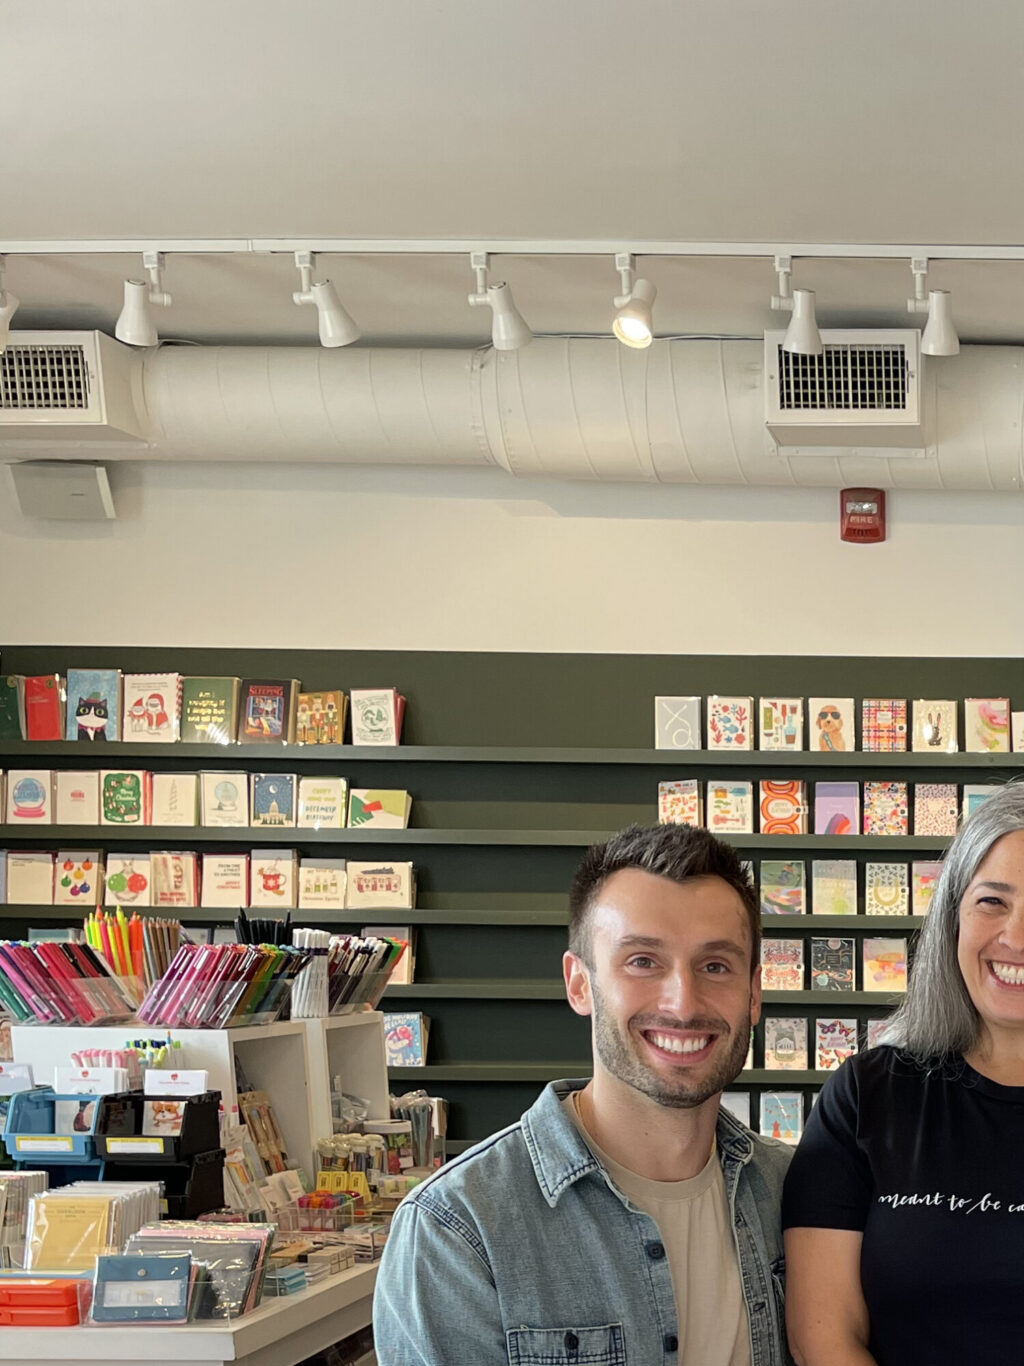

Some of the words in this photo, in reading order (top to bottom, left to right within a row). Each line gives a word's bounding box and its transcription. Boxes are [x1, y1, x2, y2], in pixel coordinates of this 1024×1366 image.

[849, 515, 873, 524] FIRE
[878, 1192, 945, 1209] meant
[947, 1193, 973, 1212] to
[965, 1192, 1001, 1215] be
